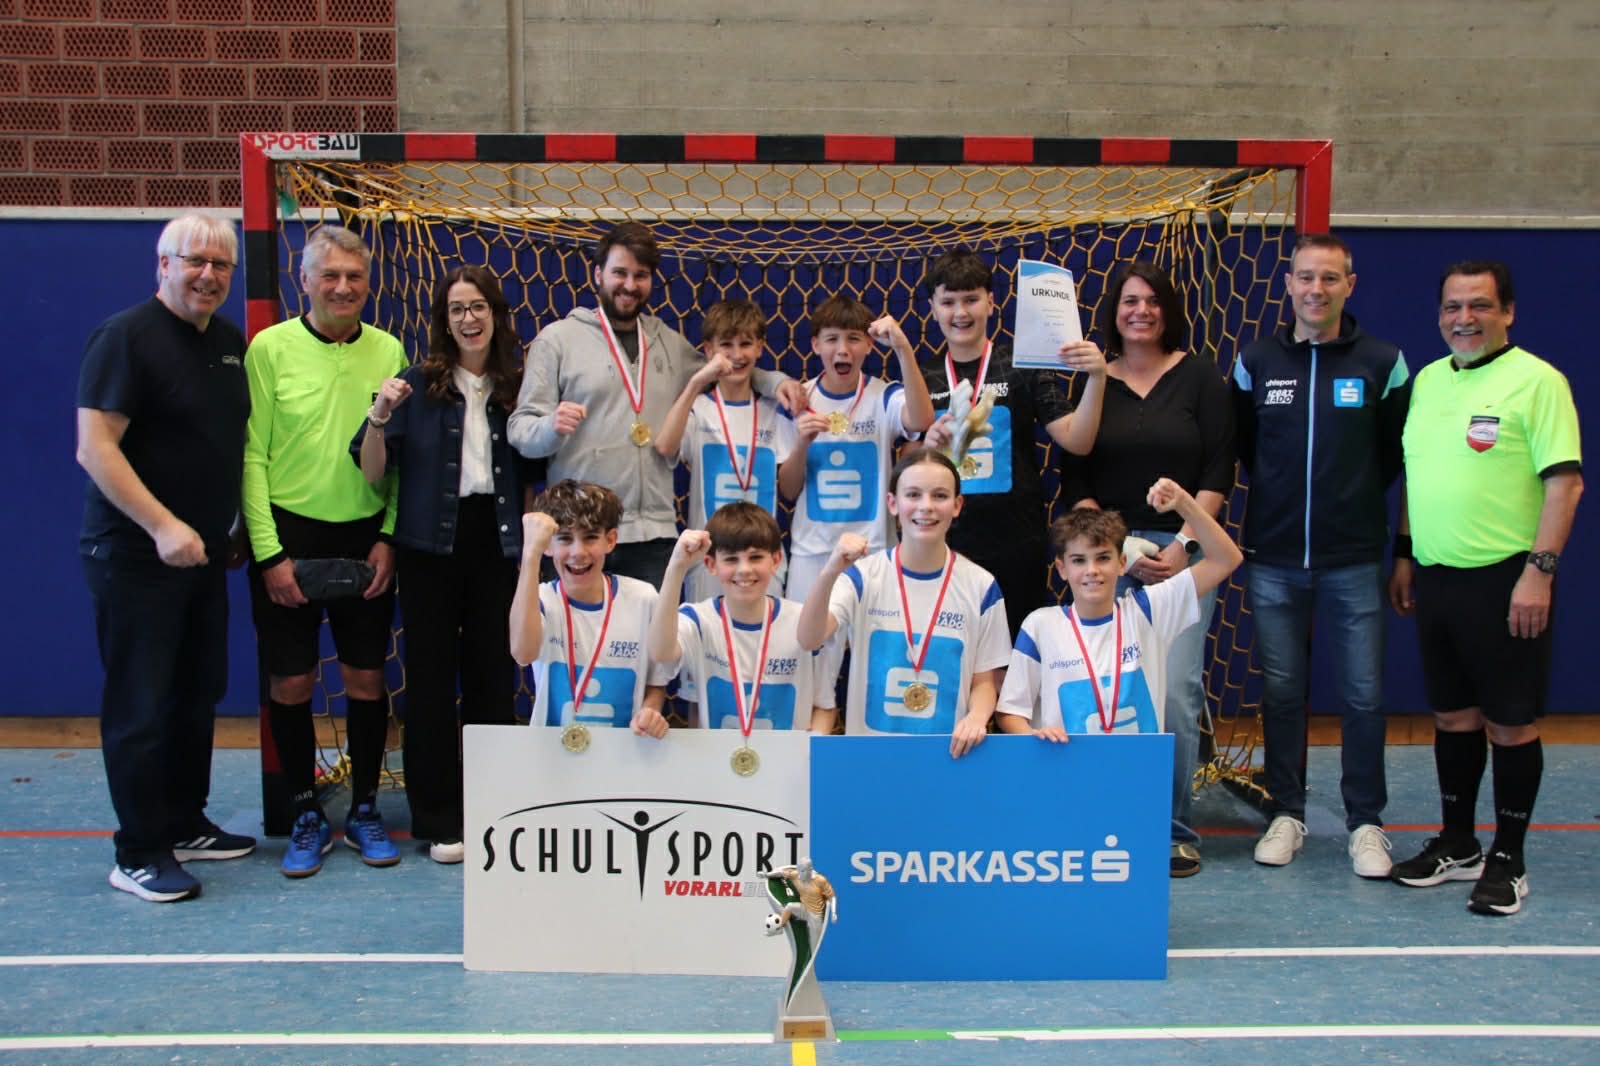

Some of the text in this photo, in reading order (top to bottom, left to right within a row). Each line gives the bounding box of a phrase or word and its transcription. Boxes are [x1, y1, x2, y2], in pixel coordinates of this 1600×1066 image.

[1031, 287, 1071, 301] URKUNDE
[1265, 379, 1298, 388] uhlsport
[1049, 657, 1085, 670] uhlsport
[667, 830, 804, 877] SPORT
[850, 850, 1084, 883] SPARKASSE
